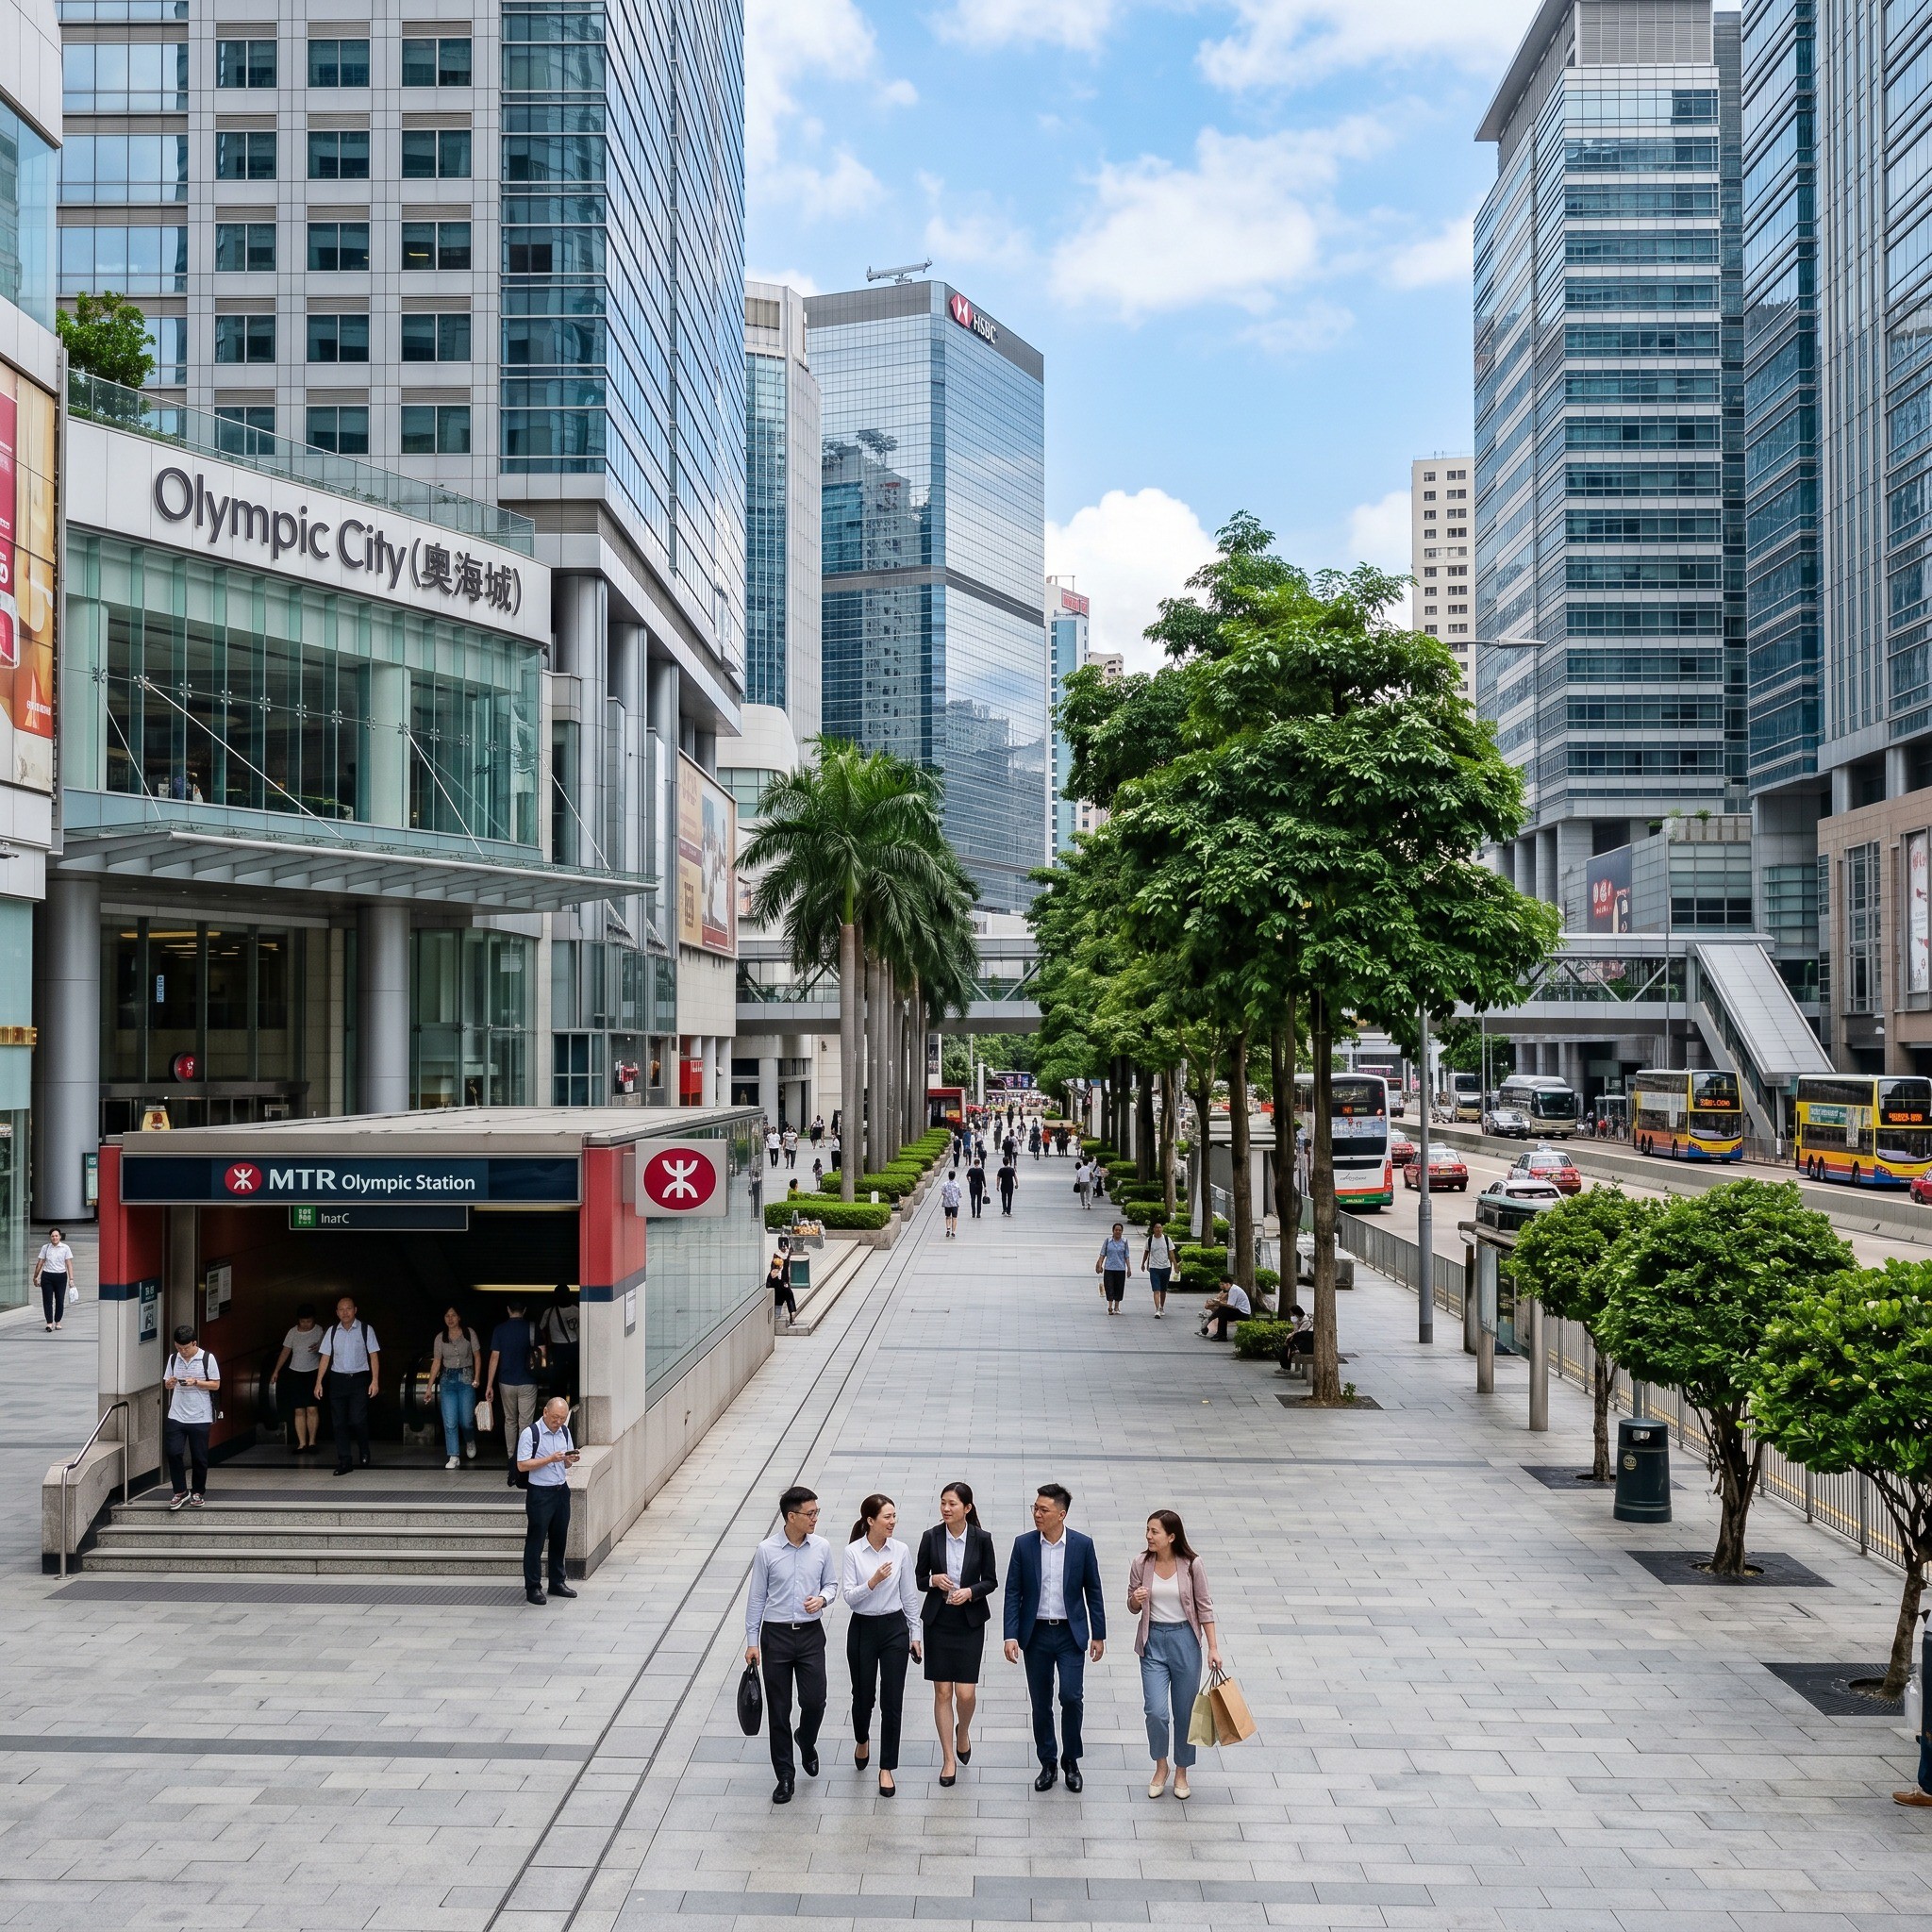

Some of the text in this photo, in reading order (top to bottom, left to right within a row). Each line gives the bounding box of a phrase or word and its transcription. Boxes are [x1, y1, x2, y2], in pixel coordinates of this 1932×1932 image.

[973, 312, 996, 344] HSBC
[155, 467, 330, 560] Olympic
[337, 519, 408, 590] City
[268, 1169, 475, 1194] MTR Olympic Station
